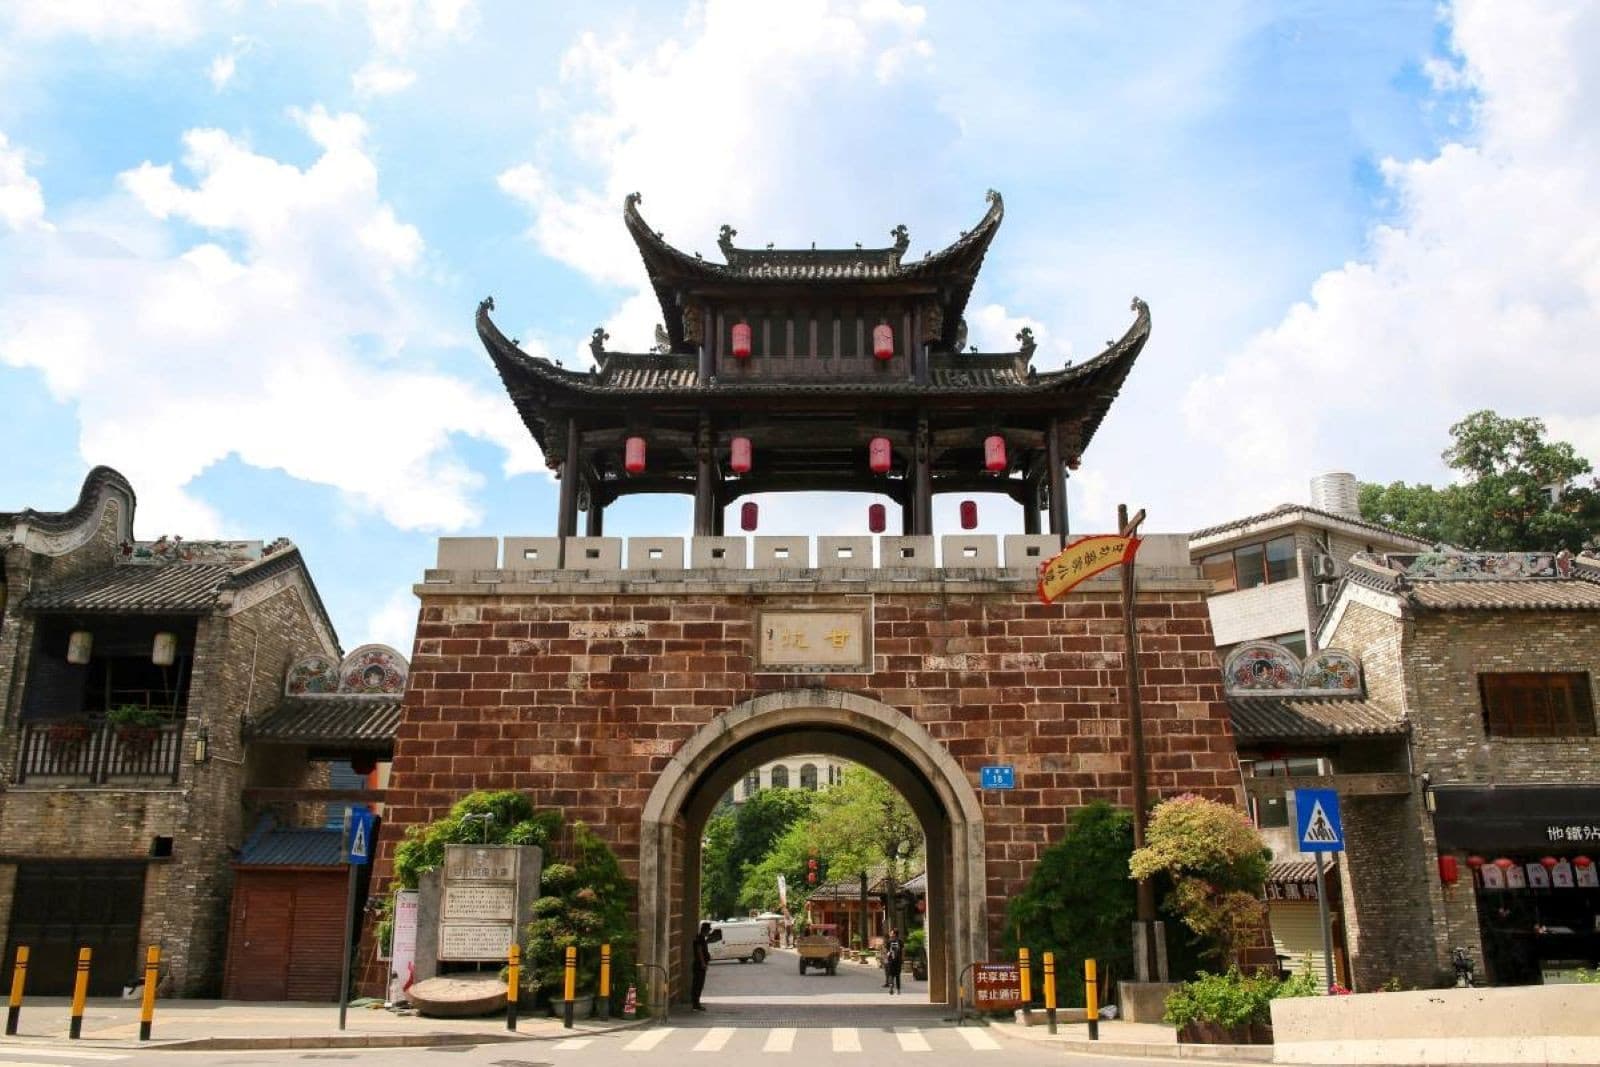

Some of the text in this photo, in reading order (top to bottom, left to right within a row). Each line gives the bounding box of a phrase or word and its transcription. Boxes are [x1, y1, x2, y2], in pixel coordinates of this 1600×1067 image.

[976, 971, 1020, 983] 共享单车
[976, 988, 1021, 1001] 禁止通行
